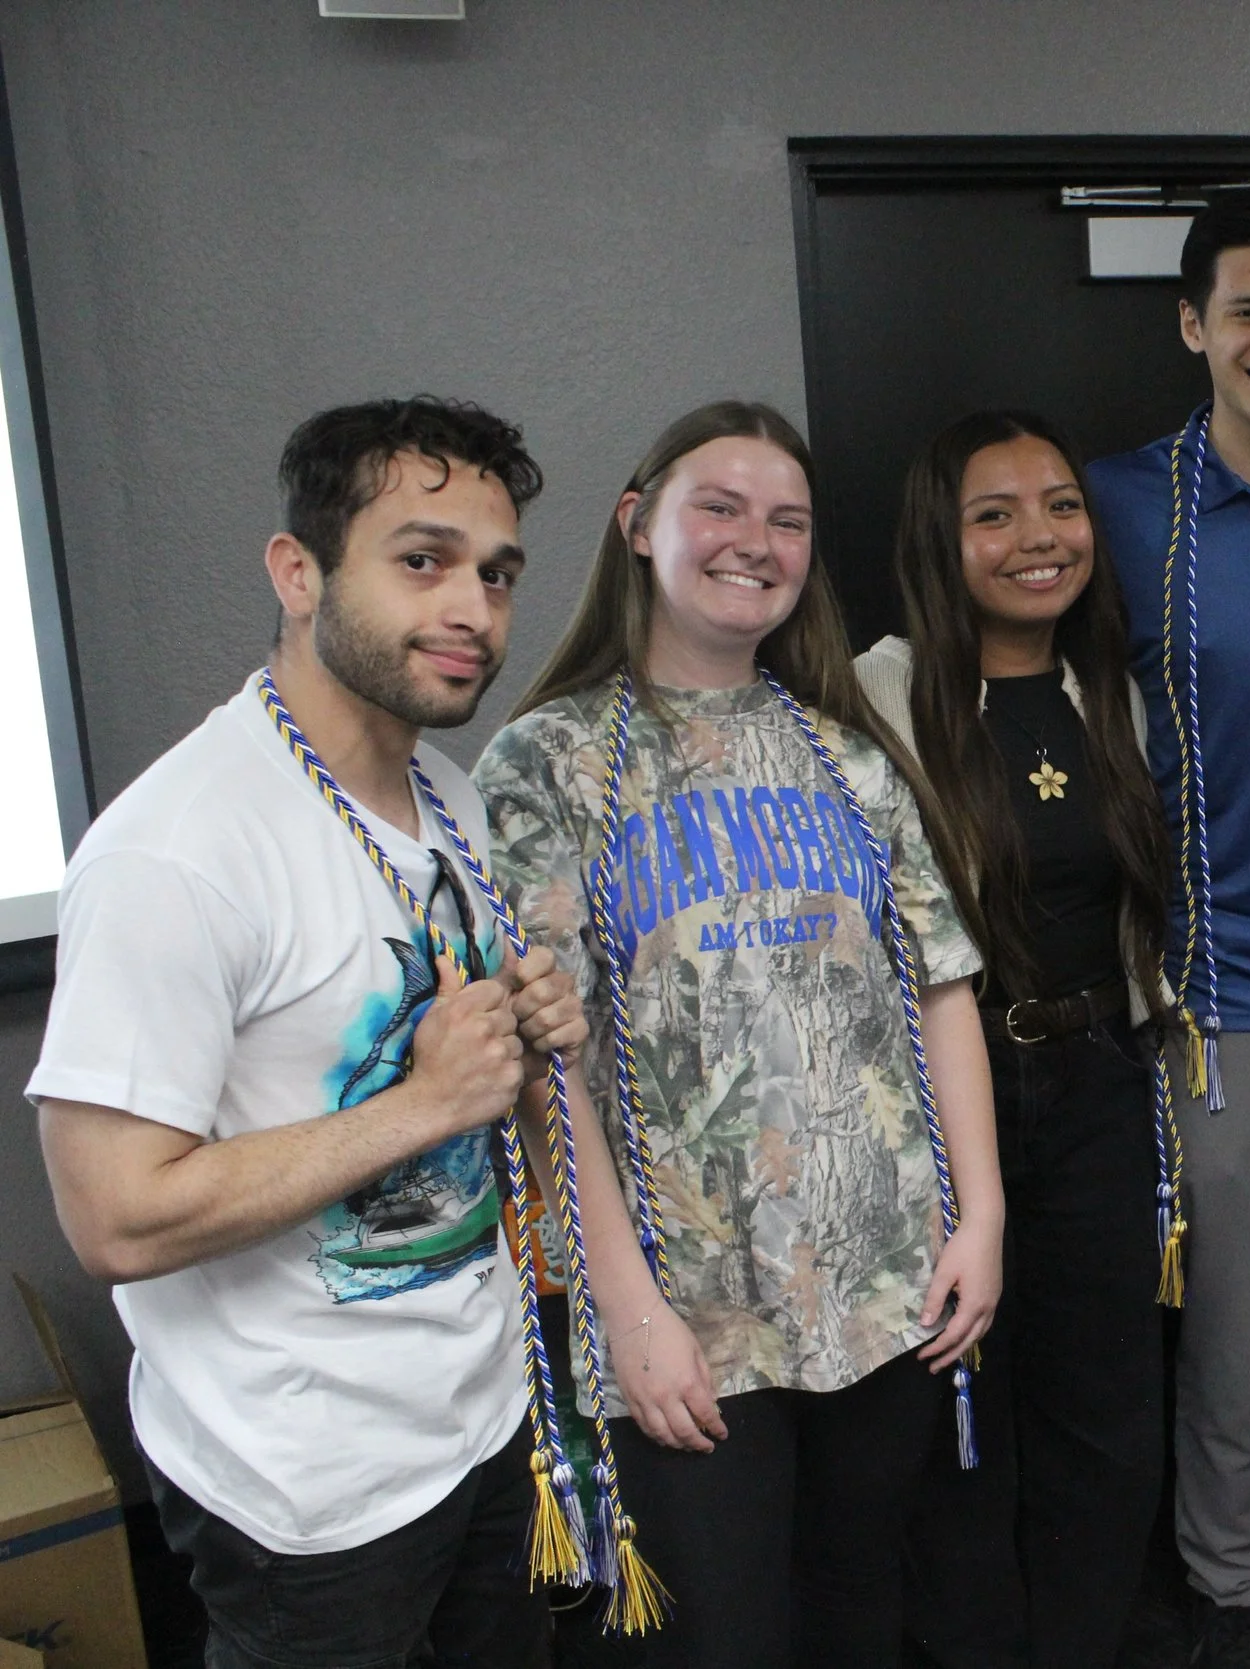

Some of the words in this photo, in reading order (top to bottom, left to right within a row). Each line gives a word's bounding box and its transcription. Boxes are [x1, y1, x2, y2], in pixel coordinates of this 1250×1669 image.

[698, 922, 737, 952] AM
[743, 921, 754, 948] I
[759, 911, 837, 947] OKAY?
